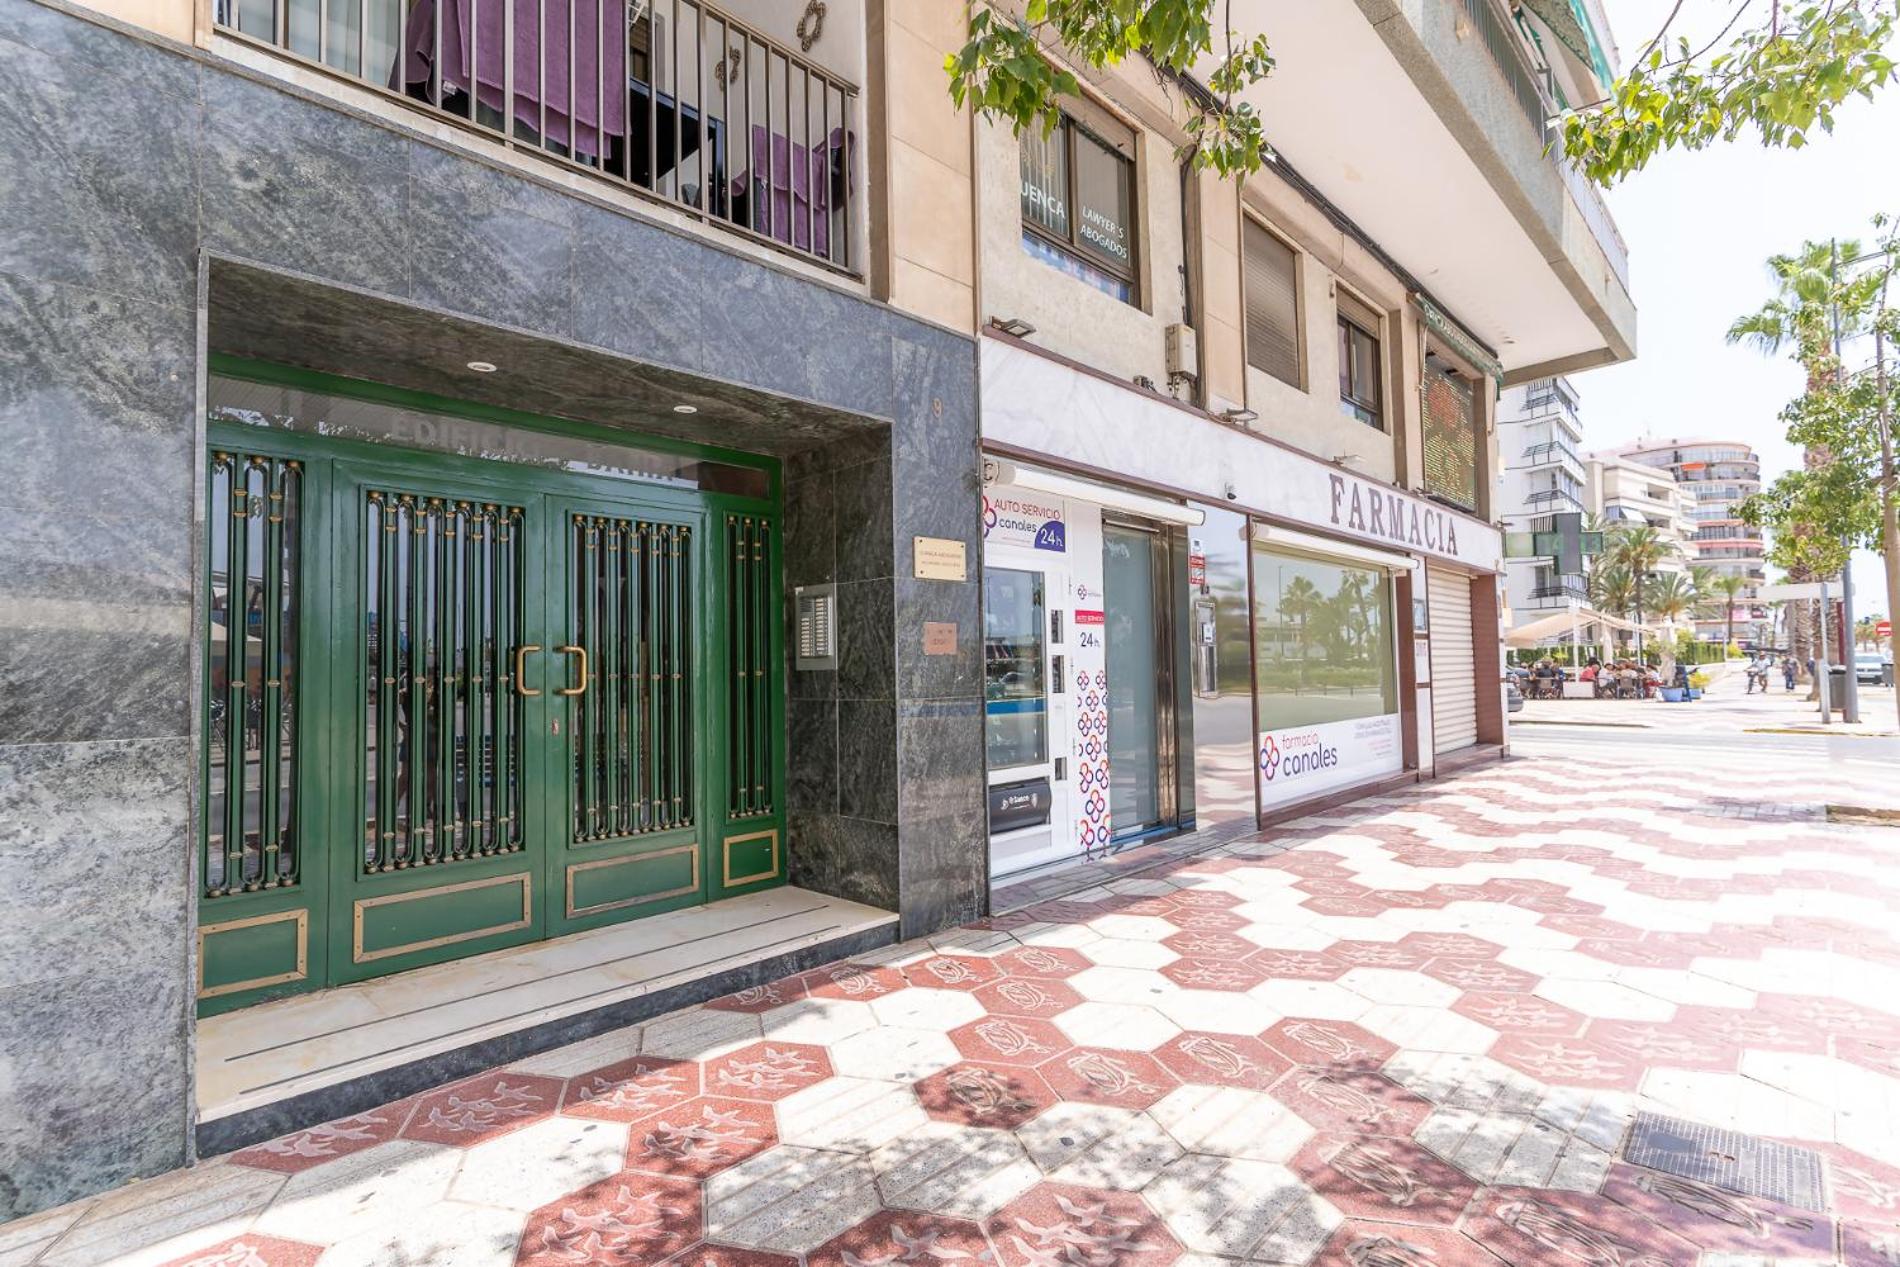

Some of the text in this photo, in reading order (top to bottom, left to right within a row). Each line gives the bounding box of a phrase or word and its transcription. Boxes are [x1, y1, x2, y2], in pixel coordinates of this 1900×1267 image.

[1080, 224, 1127, 259] ABOGADOS
[994, 498, 1061, 520] AUTO SERVICIO
[1329, 473, 1458, 556] FARMACIA
[1040, 527, 1063, 547] 24h
[1282, 742, 1338, 777] canales
